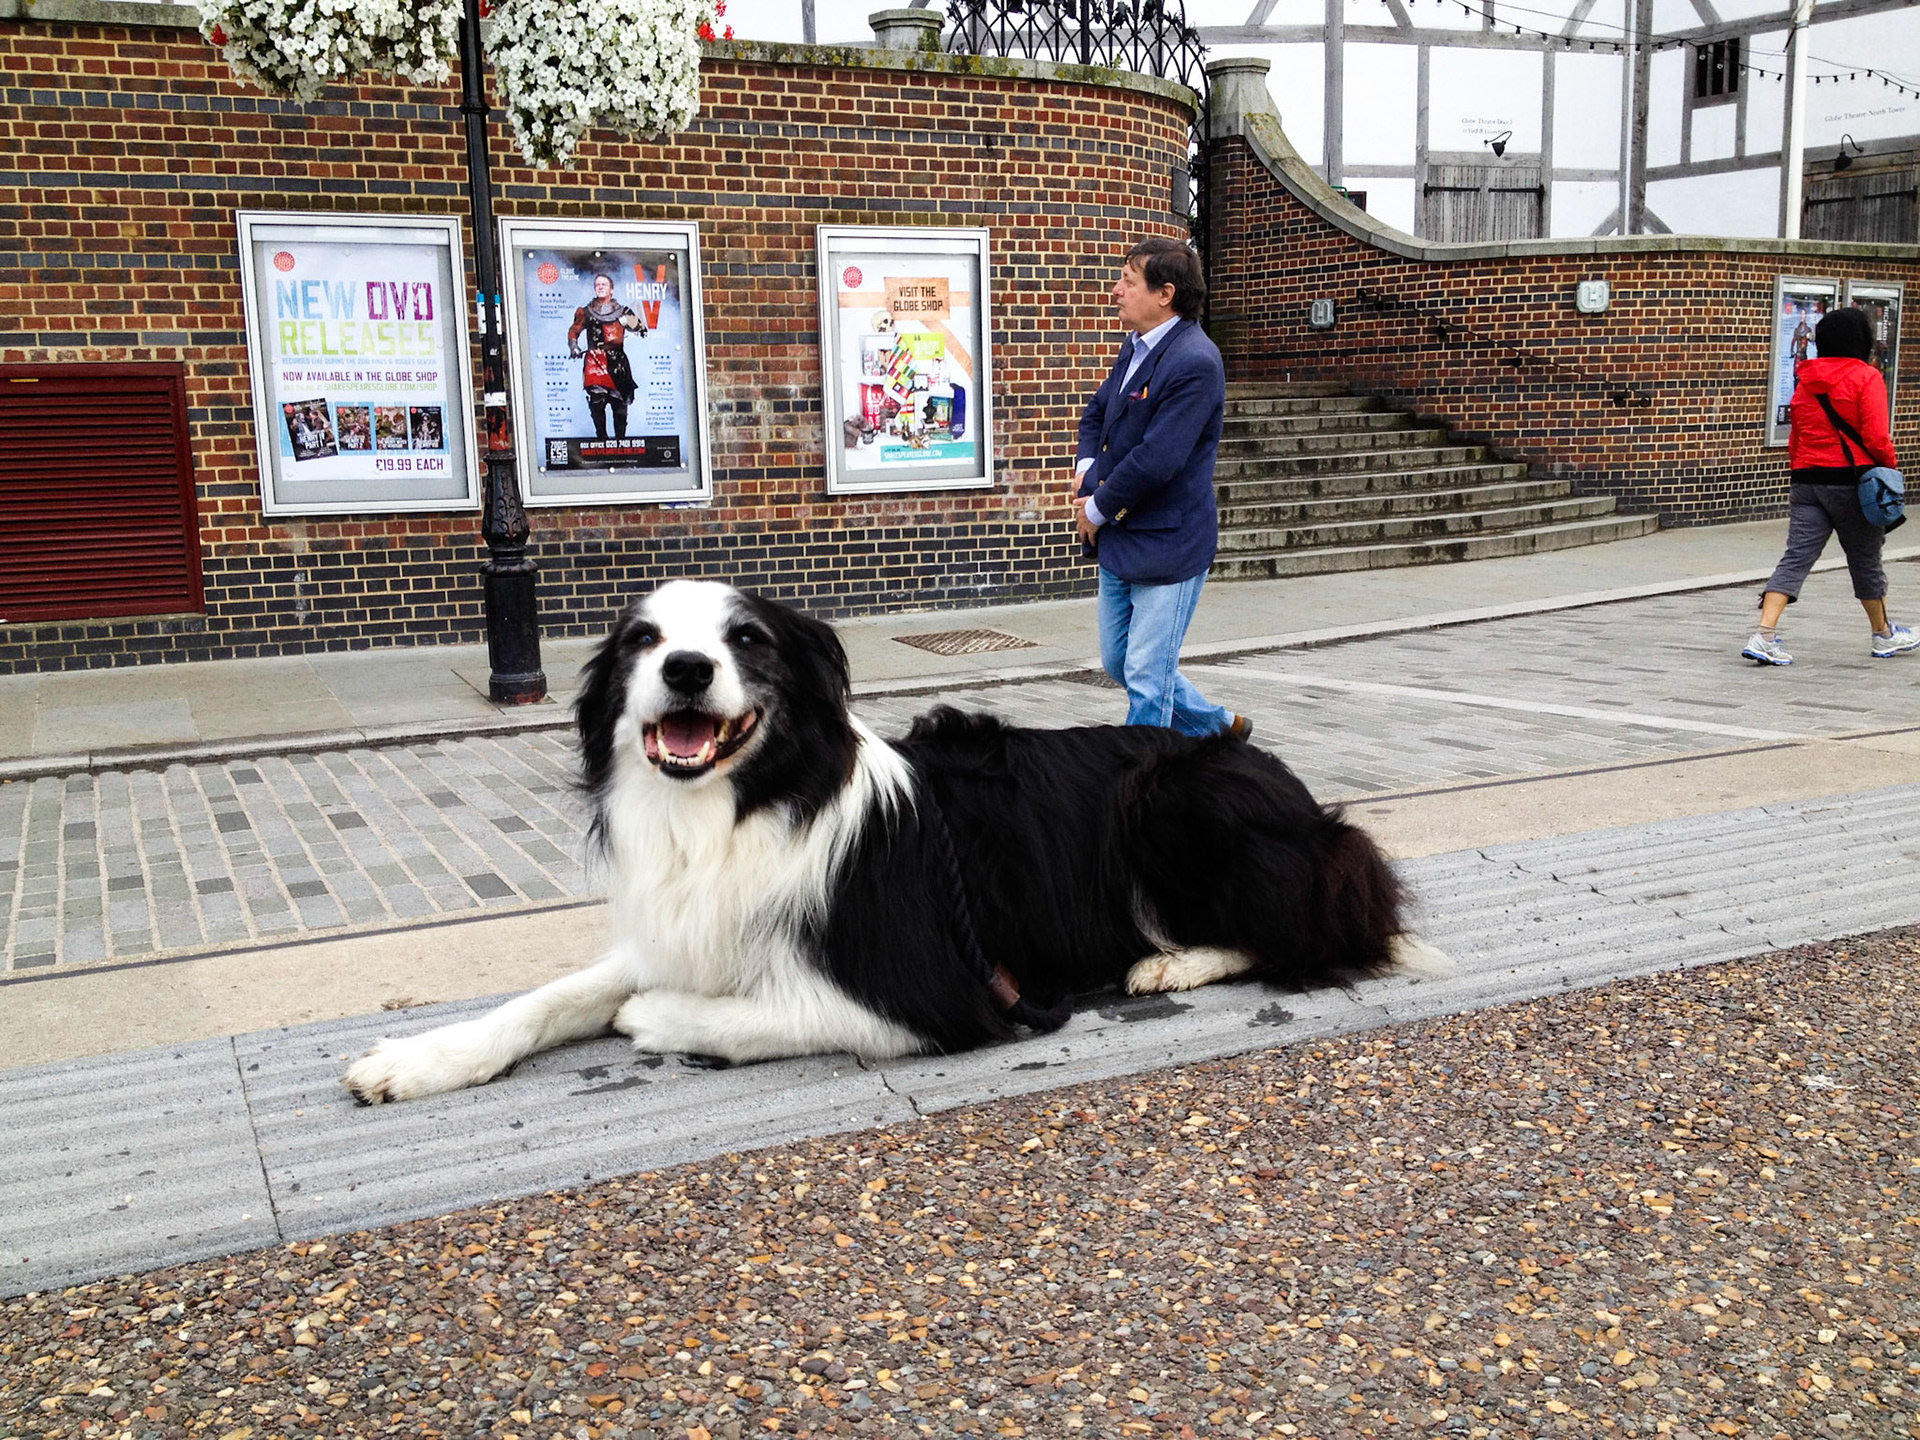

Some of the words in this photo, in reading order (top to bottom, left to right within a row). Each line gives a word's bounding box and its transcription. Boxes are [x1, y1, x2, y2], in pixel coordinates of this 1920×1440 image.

[626, 283, 667, 300] HENRY
[899, 287, 918, 297] VISIT
[921, 286, 936, 297] THE
[276, 280, 356, 319] NEW
[366, 281, 434, 321] DVD
[893, 300, 919, 311] GLOBE
[921, 300, 943, 311] SHOP
[279, 321, 435, 355] RELEASES
[283, 371, 302, 381] NOW
[307, 371, 351, 381] AVAILABLE
[354, 371, 362, 381] IN
[366, 371, 382, 381] THE
[385, 371, 412, 381] GLOBE
[415, 371, 438, 381] SHOP
[606, 440, 617, 448] 020
[376, 458, 411, 471] £19.99
[416, 458, 443, 470] EACH
